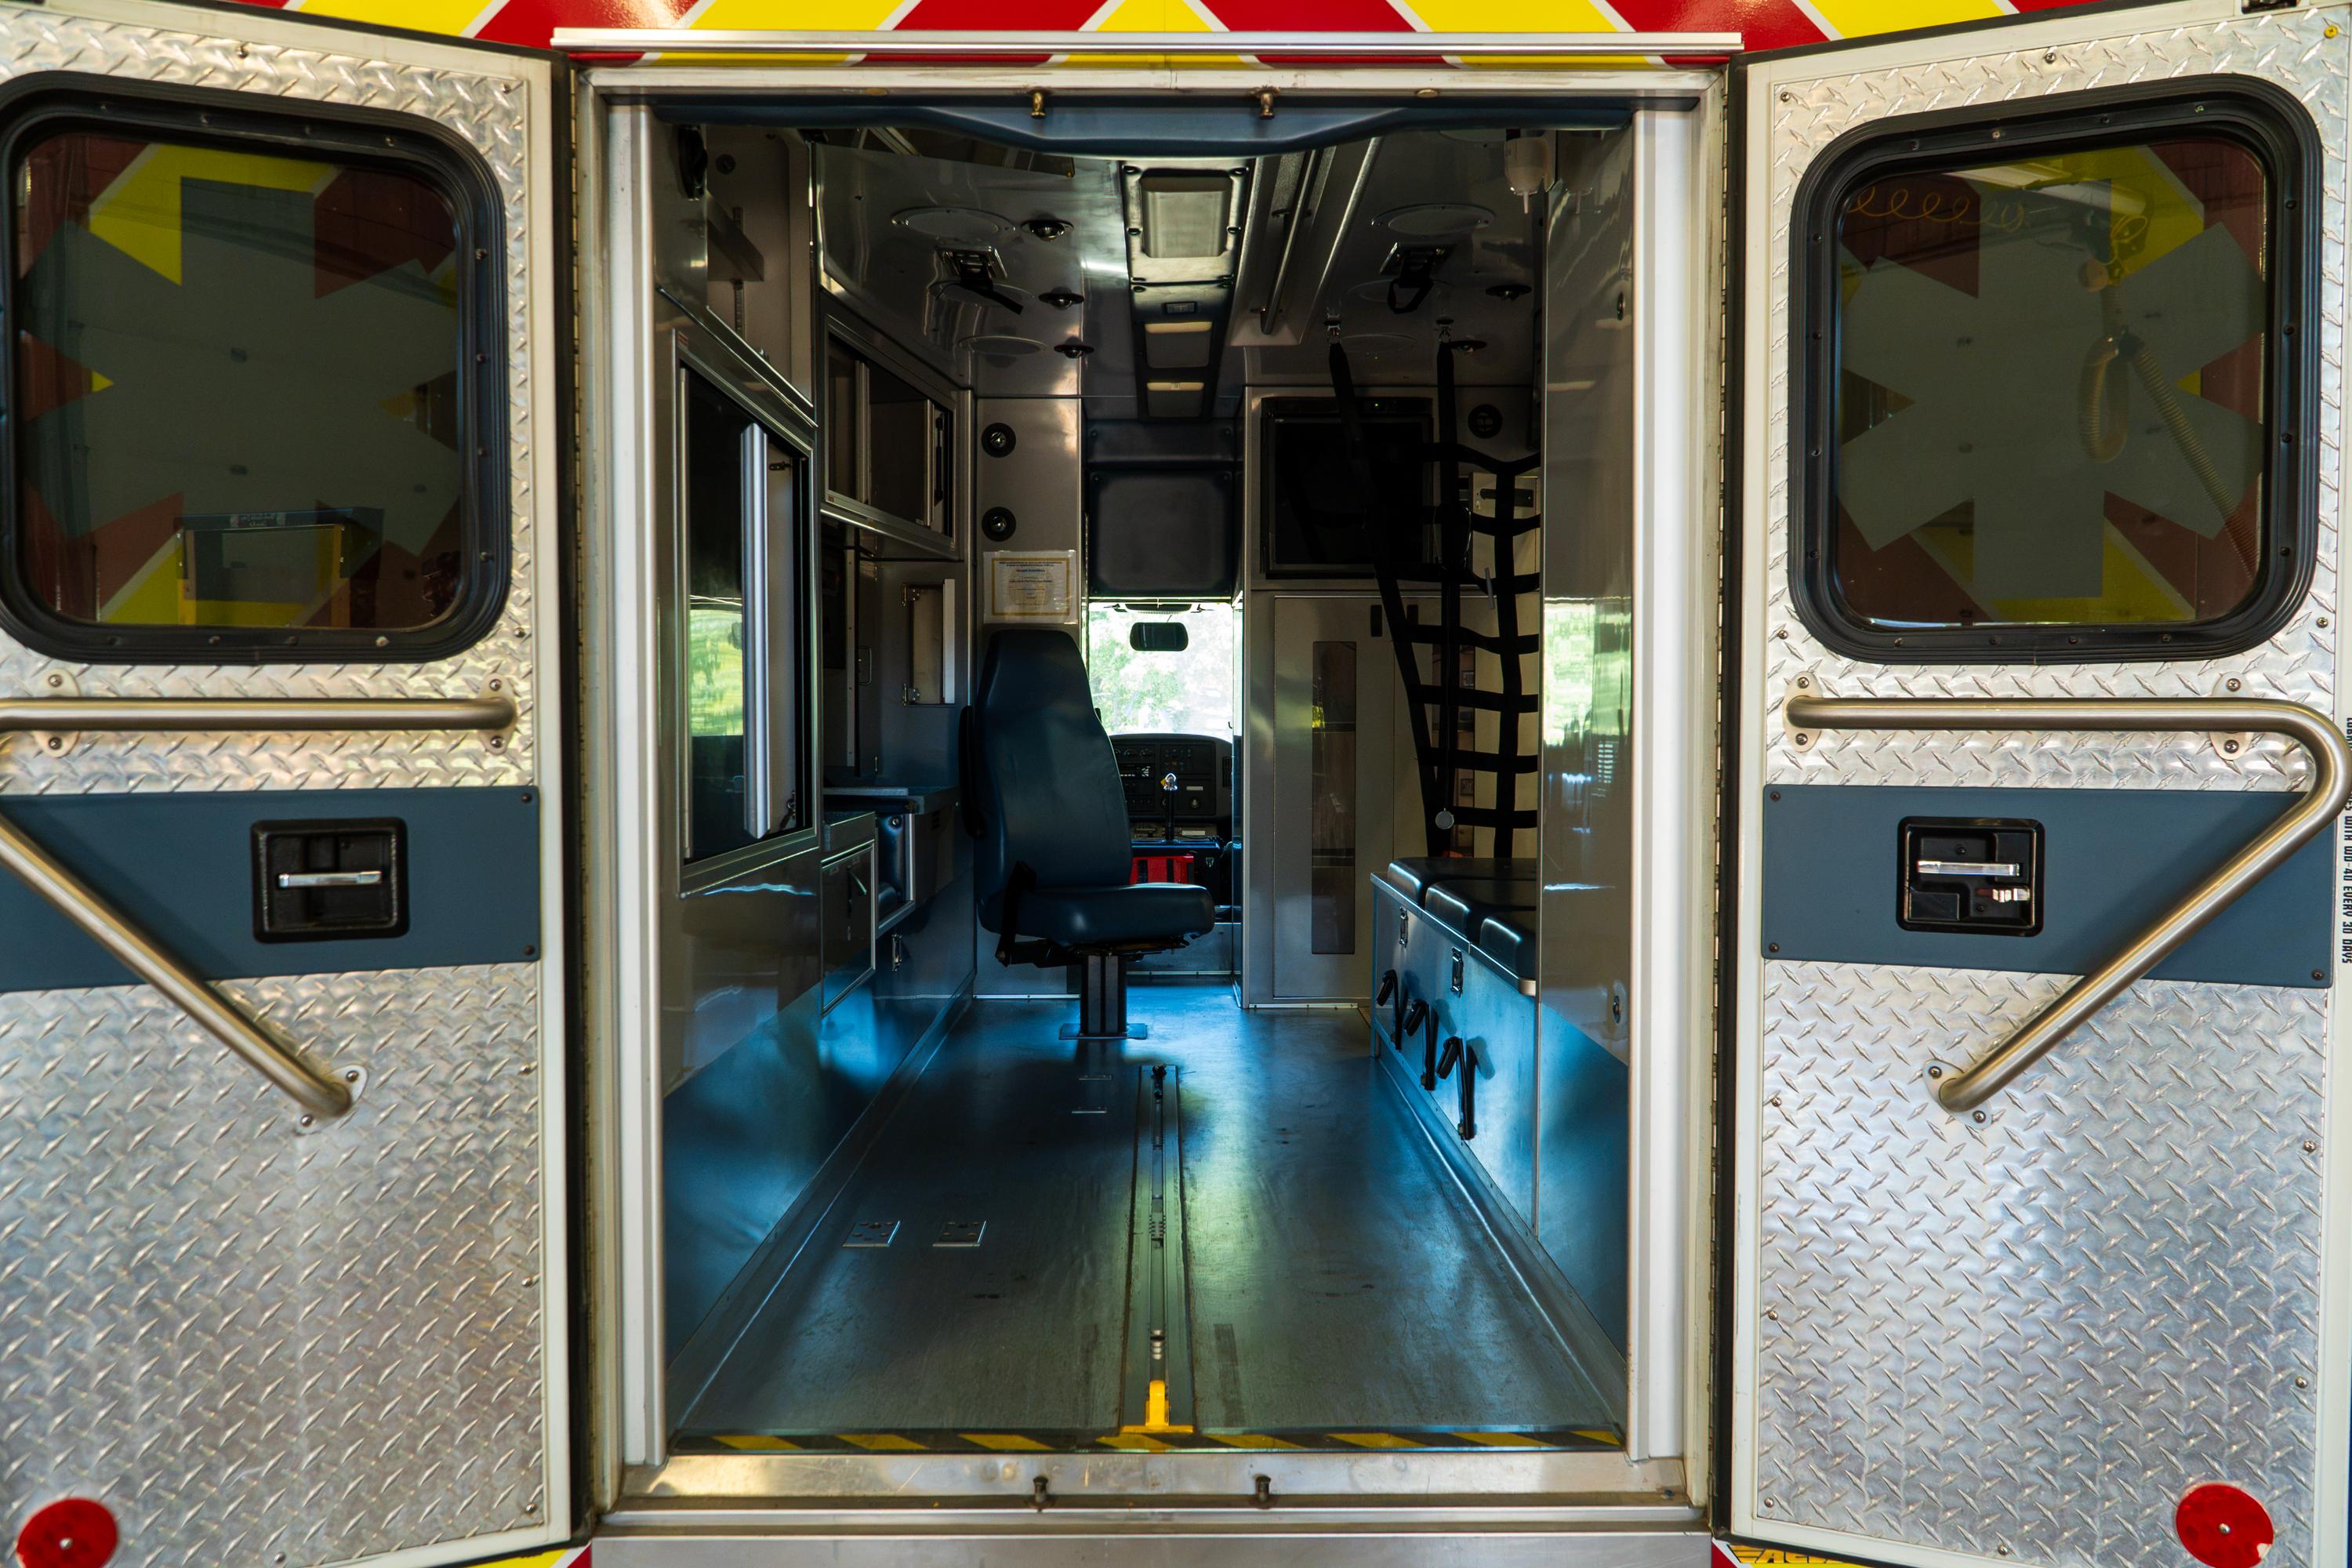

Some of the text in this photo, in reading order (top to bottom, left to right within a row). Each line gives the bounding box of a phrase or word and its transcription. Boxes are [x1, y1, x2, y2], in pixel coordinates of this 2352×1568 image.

[2343, 886, 2352, 916] EVERY
[2343, 922, 2352, 934] 30
[2342, 939, 2352, 964] DAYS
